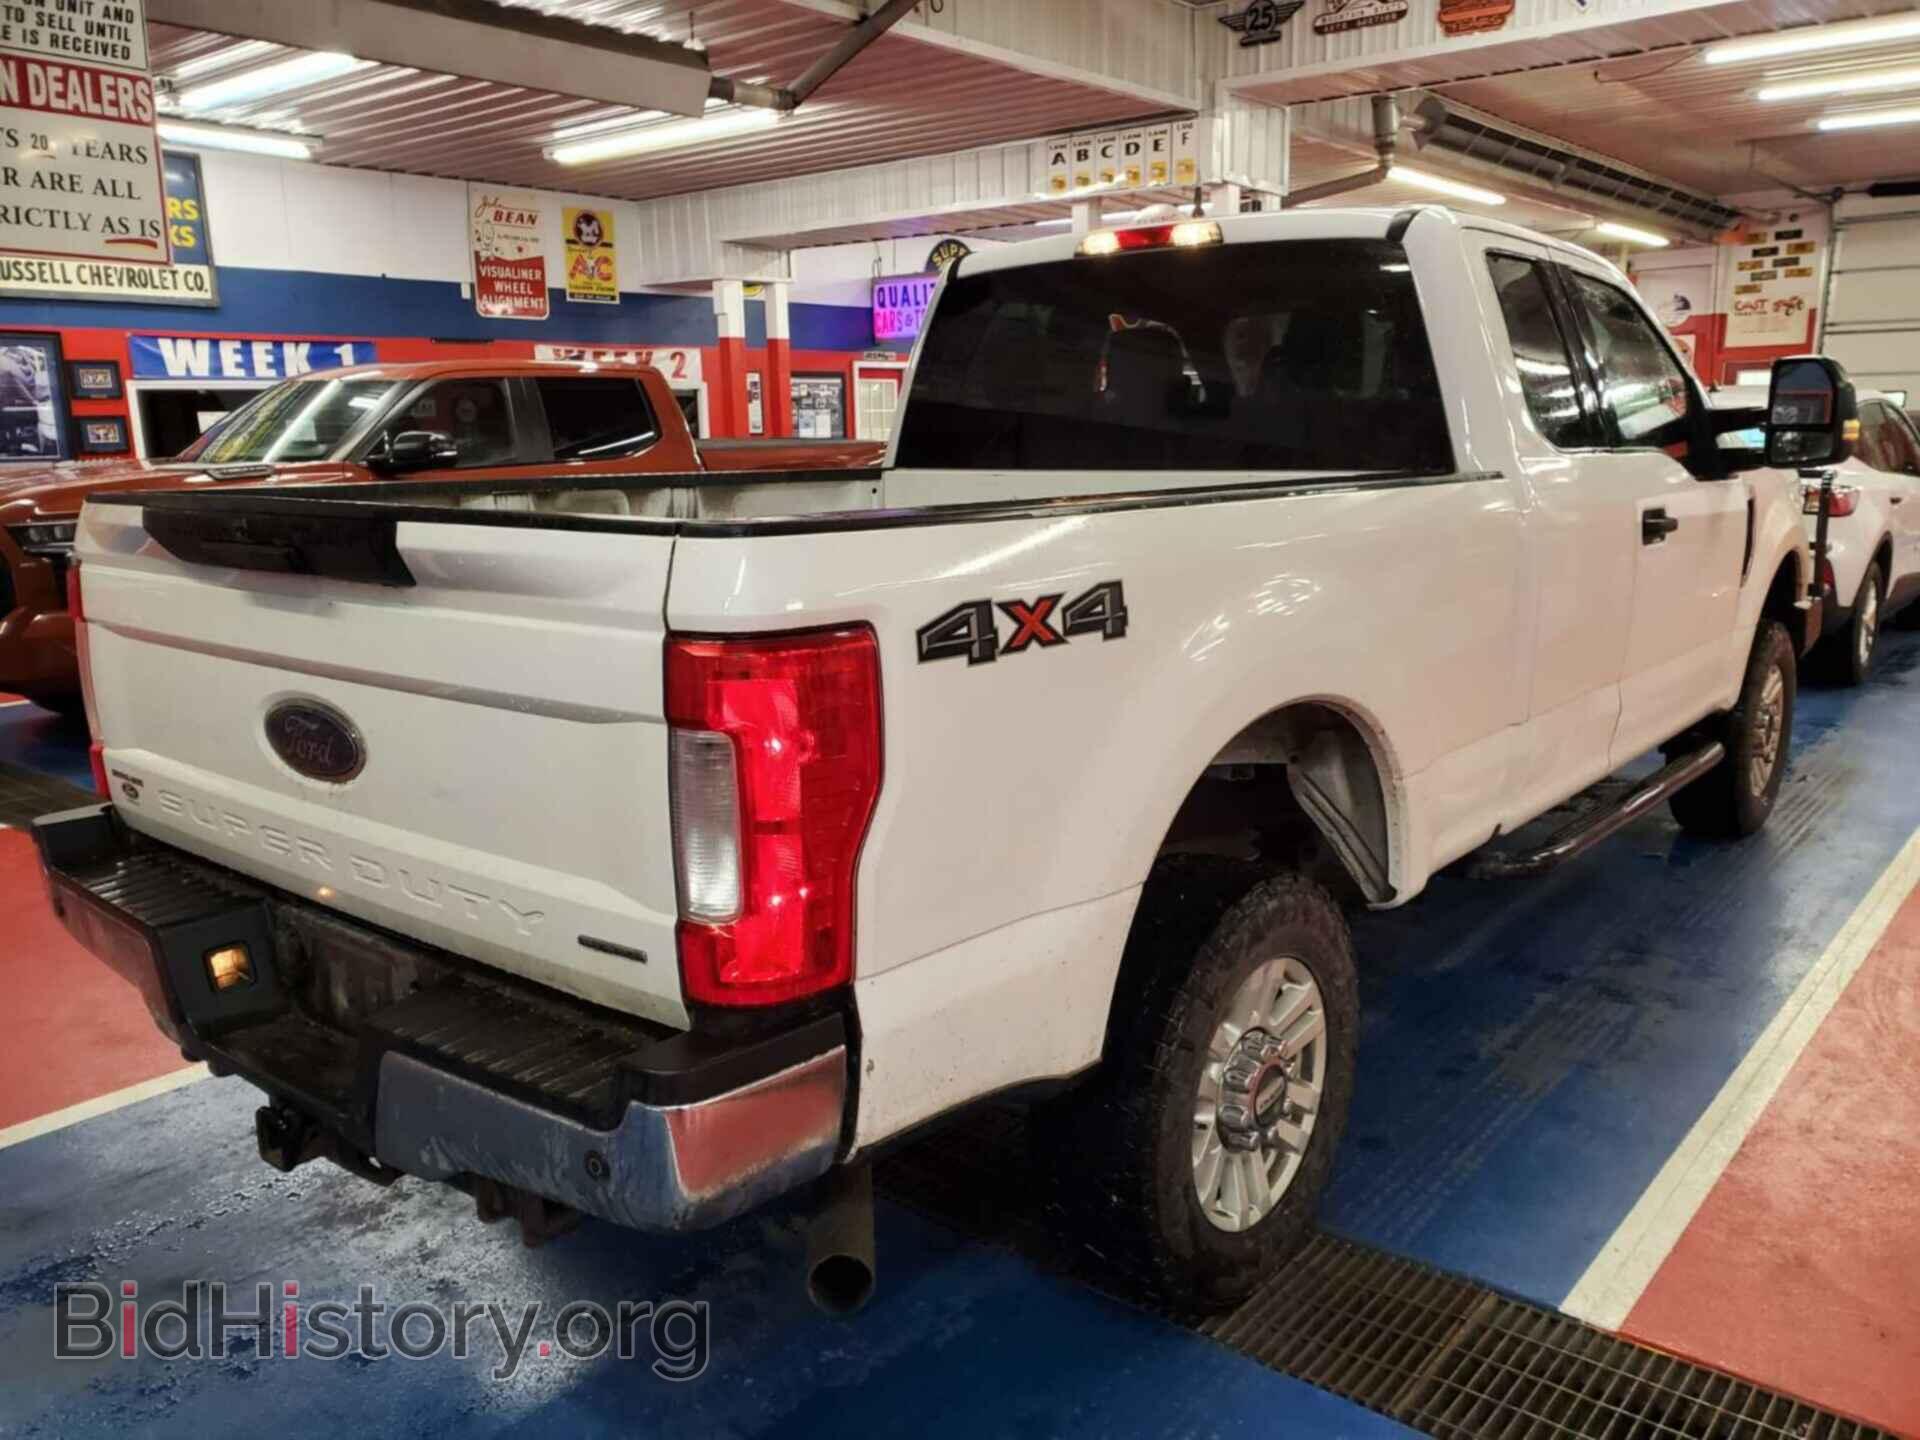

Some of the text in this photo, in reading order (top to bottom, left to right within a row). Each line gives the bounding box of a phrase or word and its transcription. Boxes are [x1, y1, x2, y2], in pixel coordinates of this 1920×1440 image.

[3, 5, 132, 42] TO SELL UNTIL
[102, 5, 134, 24] AND
[1250, 8, 1274, 31] 25
[22, 29, 39, 45] IS
[50, 33, 131, 60] RECEIVED
[26, 62, 152, 122] DEALERS
[31, 133, 48, 150] 20
[1153, 139, 1165, 152] E
[1182, 131, 1190, 145] F
[1077, 148, 1089, 162] B
[1101, 145, 1113, 158] C
[1125, 142, 1140, 156] D
[1051, 152, 1066, 166] A
[30, 171, 84, 193] ARE
[93, 179, 141, 200] ALL
[493, 209, 537, 225] BEAN
[101, 216, 130, 235] AS
[140, 219, 161, 238] IS
[76, 264, 179, 290] CHEVROLET
[183, 271, 209, 293] CO.
[480, 265, 542, 280] VISUALINER
[493, 280, 533, 295] WHEEL
[480, 294, 545, 310] ALIGNMENT
[157, 338, 355, 377] WEEK 1
[670, 351, 687, 379] 2
[158, 788, 545, 937] SUPER DUTY
